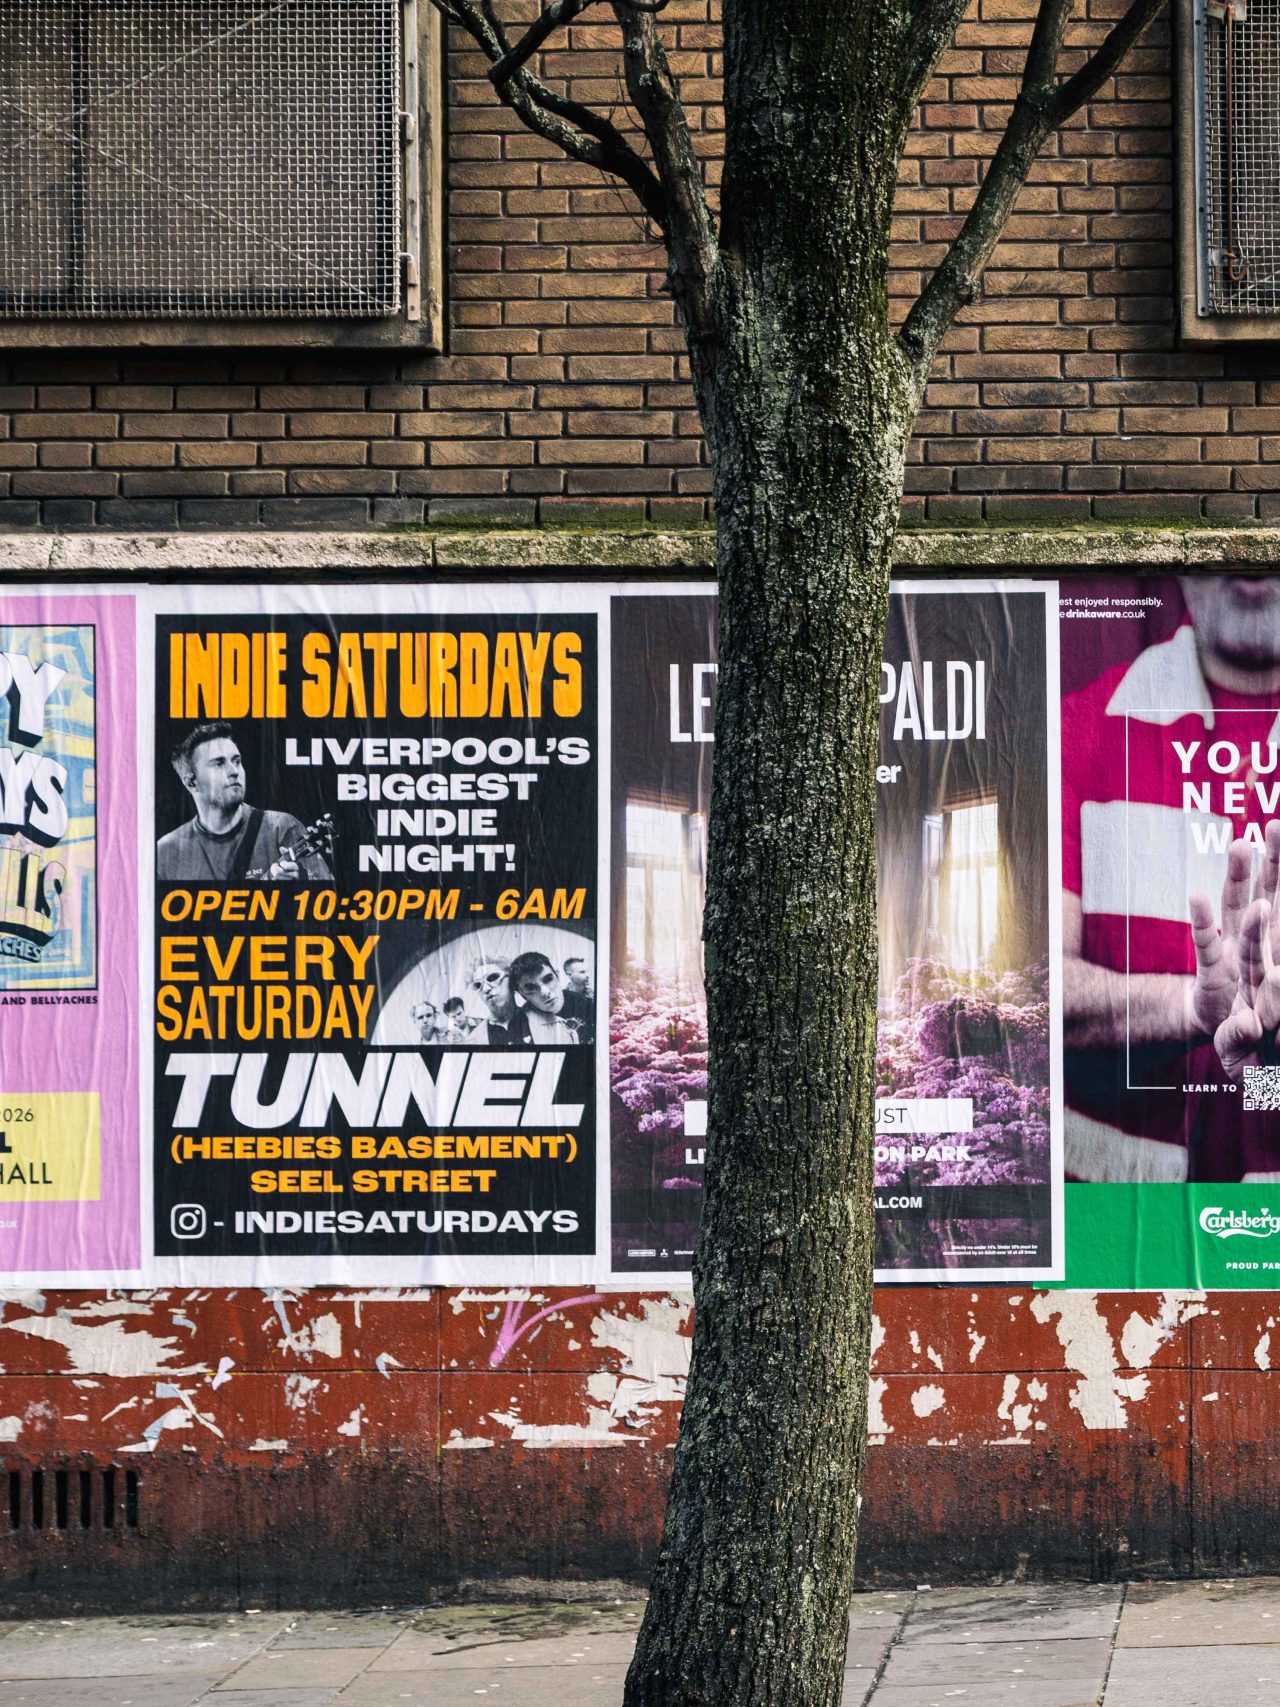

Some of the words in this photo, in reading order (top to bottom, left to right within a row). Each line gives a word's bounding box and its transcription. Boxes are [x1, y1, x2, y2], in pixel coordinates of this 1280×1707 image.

[1059, 598, 1073, 606] est
[1074, 597, 1109, 607] enjoyed
[1111, 596, 1163, 608] responsibly.
[169, 632, 287, 719] INDIE
[302, 632, 582, 718] SATURDAYS
[0, 651, 67, 745] Y
[669, 663, 719, 742] LE
[878, 660, 986, 740] PALDI
[285, 737, 590, 766] LIVERPOOL'S
[337, 773, 537, 801] BIGGEST
[875, 765, 902, 783] er
[0, 747, 68, 845] YS
[377, 808, 498, 837] INDIE
[358, 844, 516, 873] NIGHT!
[161, 890, 280, 922] OPEN
[293, 889, 460, 920] 10:30PM
[470, 904, 484, 912] -
[495, 888, 586, 919] 6AM
[0, 937, 42, 962] CHES
[160, 935, 380, 981] EVERY
[1, 997, 26, 1005] AND
[31, 995, 99, 1005] BELLYACHES
[156, 985, 376, 1041] SATURDAY
[164, 1051, 585, 1129] TUNNEL
[1182, 1084, 1218, 1093] LEARN
[1222, 1084, 1237, 1093] TO
[0, 1108, 34, 1122] 026
[171, 1135, 342, 1164] (HEEBIES
[351, 1132, 578, 1162] BASEMENT)
[685, 1148, 706, 1165] LI
[874, 1146, 905, 1162] ON
[911, 1145, 972, 1162] PARK
[0, 1162, 53, 1184] ALL
[250, 1169, 344, 1194] SEEL
[352, 1169, 497, 1193] STREET
[235, 1209, 579, 1235] INDIESATURDAYS
[1199, 1207, 1280, 1236] Carlsberg
[1225, 1262, 1259, 1270] PROUD
